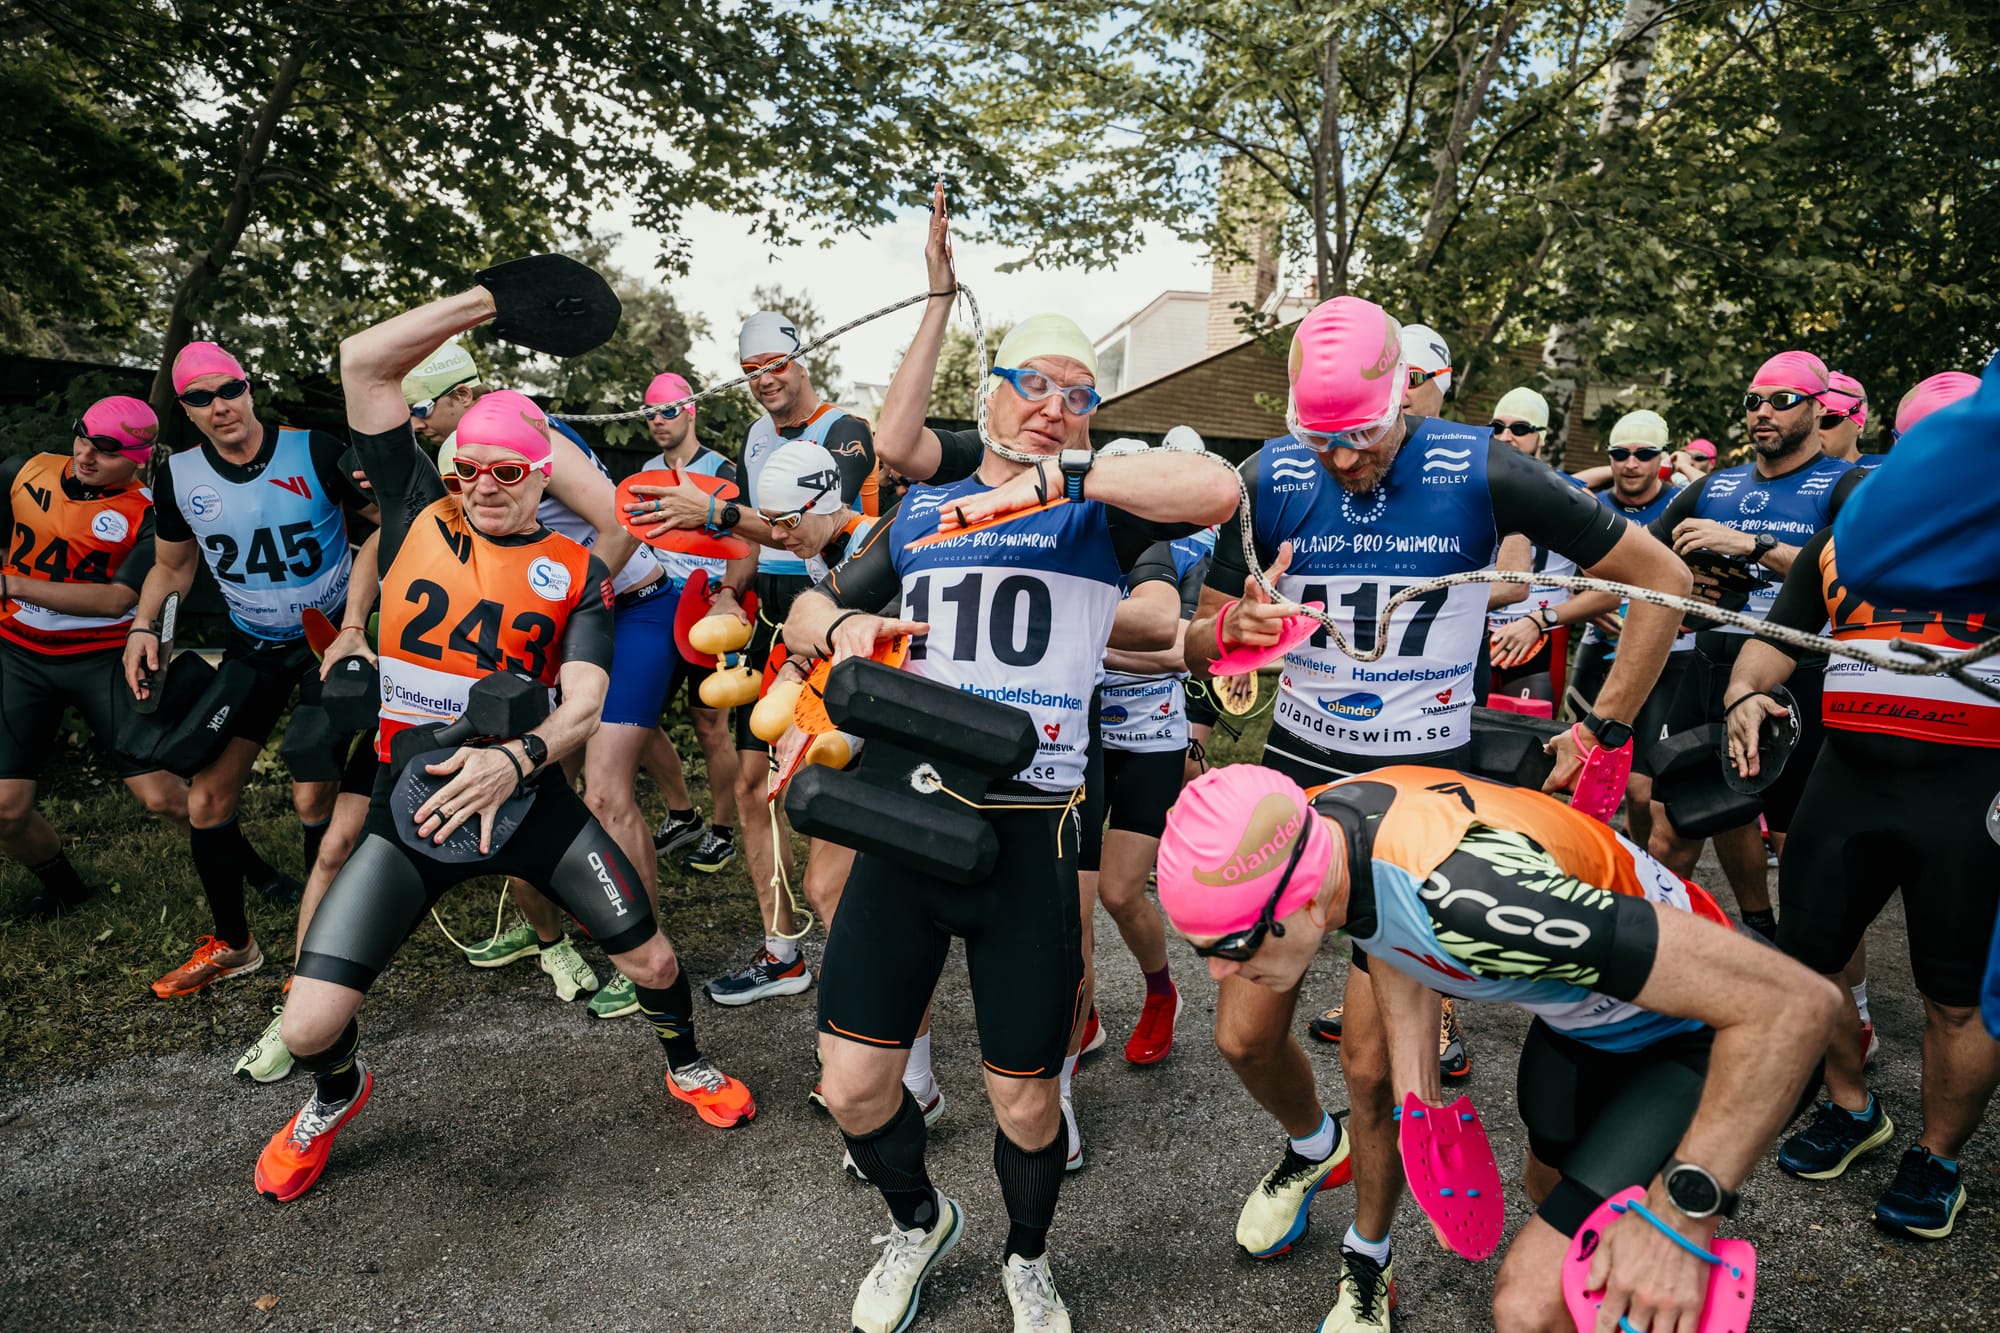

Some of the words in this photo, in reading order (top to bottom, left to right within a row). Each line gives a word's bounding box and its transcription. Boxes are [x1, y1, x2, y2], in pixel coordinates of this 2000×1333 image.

[1273, 482, 1315, 494] MEDLEY
[1422, 474, 1468, 484] MEDLEY
[1000, 532, 1057, 549] SWIMRUN
[1762, 520, 1814, 535] SWIMRUN
[11, 522, 112, 584] 244
[205, 520, 323, 584] 245
[1386, 535, 1460, 553] SWIMRUN
[400, 578, 556, 677] 243
[906, 573, 1052, 667] 110
[1352, 662, 1473, 682] Handelsbanken
[395, 685, 462, 712] Cinderella
[1327, 700, 1380, 717] olander
[1279, 701, 1451, 742] olanderswim.se
[1222, 813, 1301, 881] olander
[587, 851, 628, 917] HEAD
